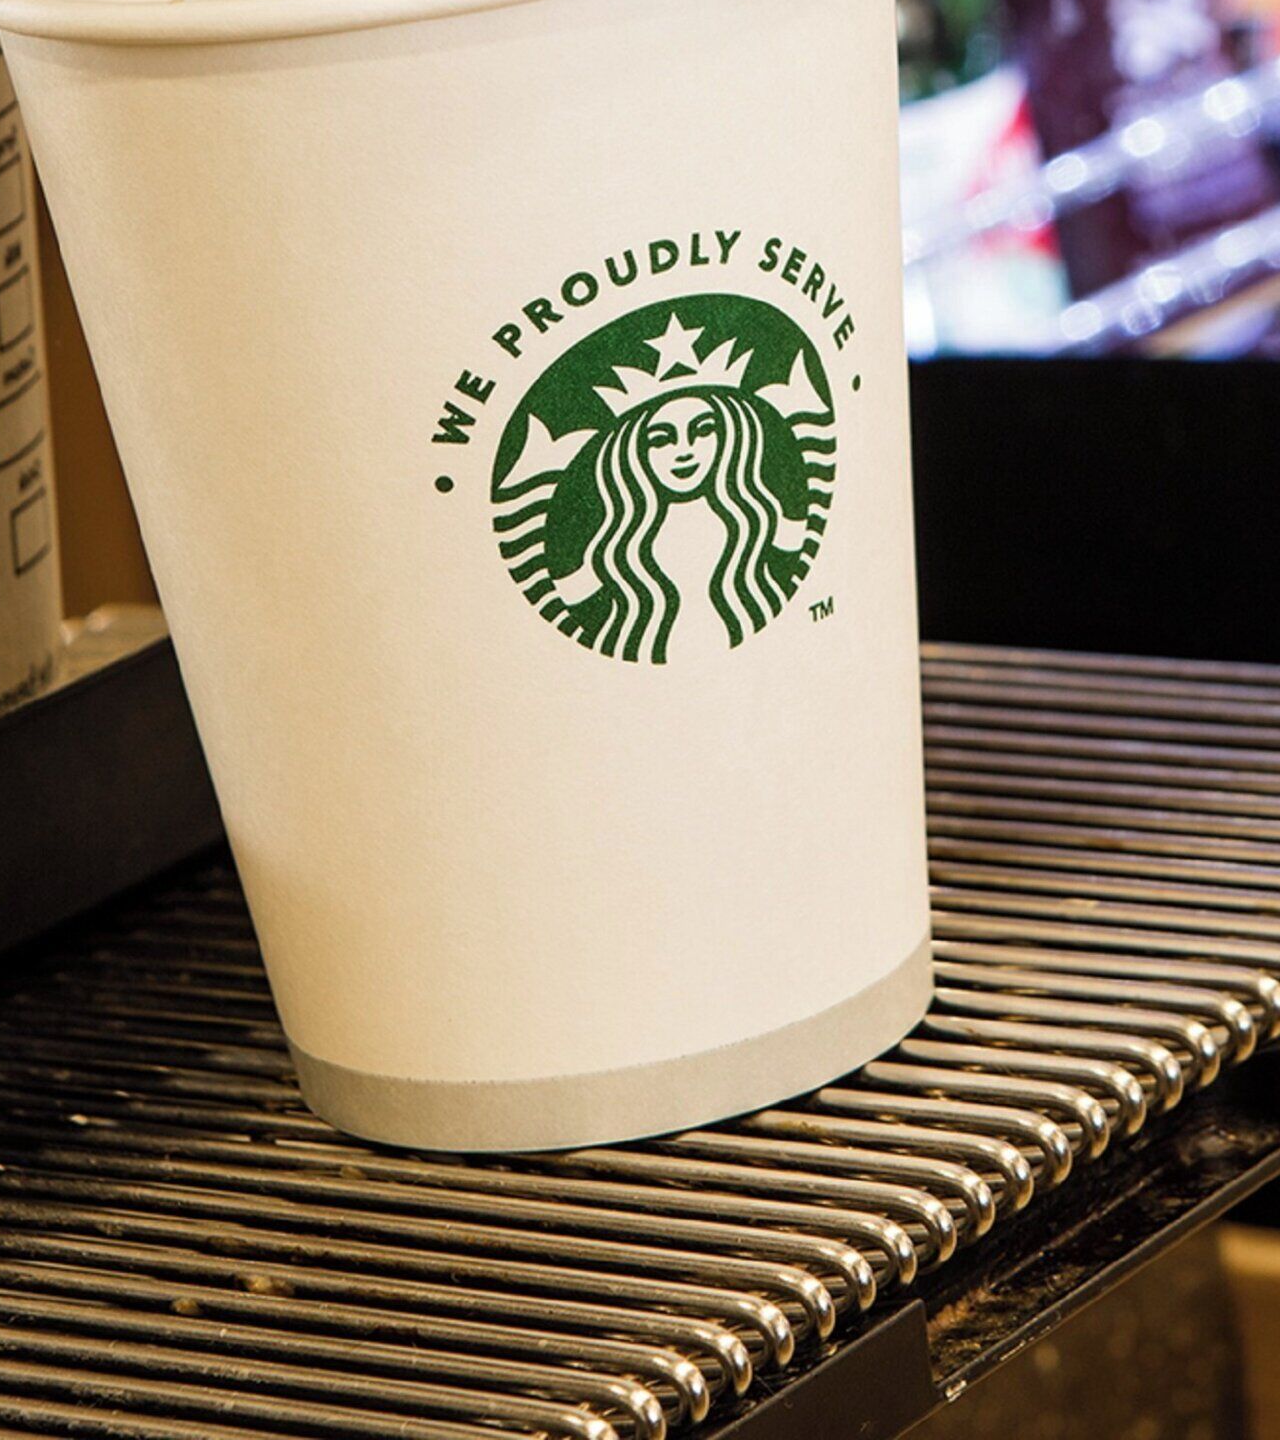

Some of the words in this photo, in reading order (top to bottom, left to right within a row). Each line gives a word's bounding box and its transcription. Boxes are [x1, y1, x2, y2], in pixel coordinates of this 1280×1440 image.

[431, 370, 496, 444] WE
[492, 230, 741, 358] PROUDLY
[758, 237, 855, 350] SERVE
[808, 595, 835, 622] TM
